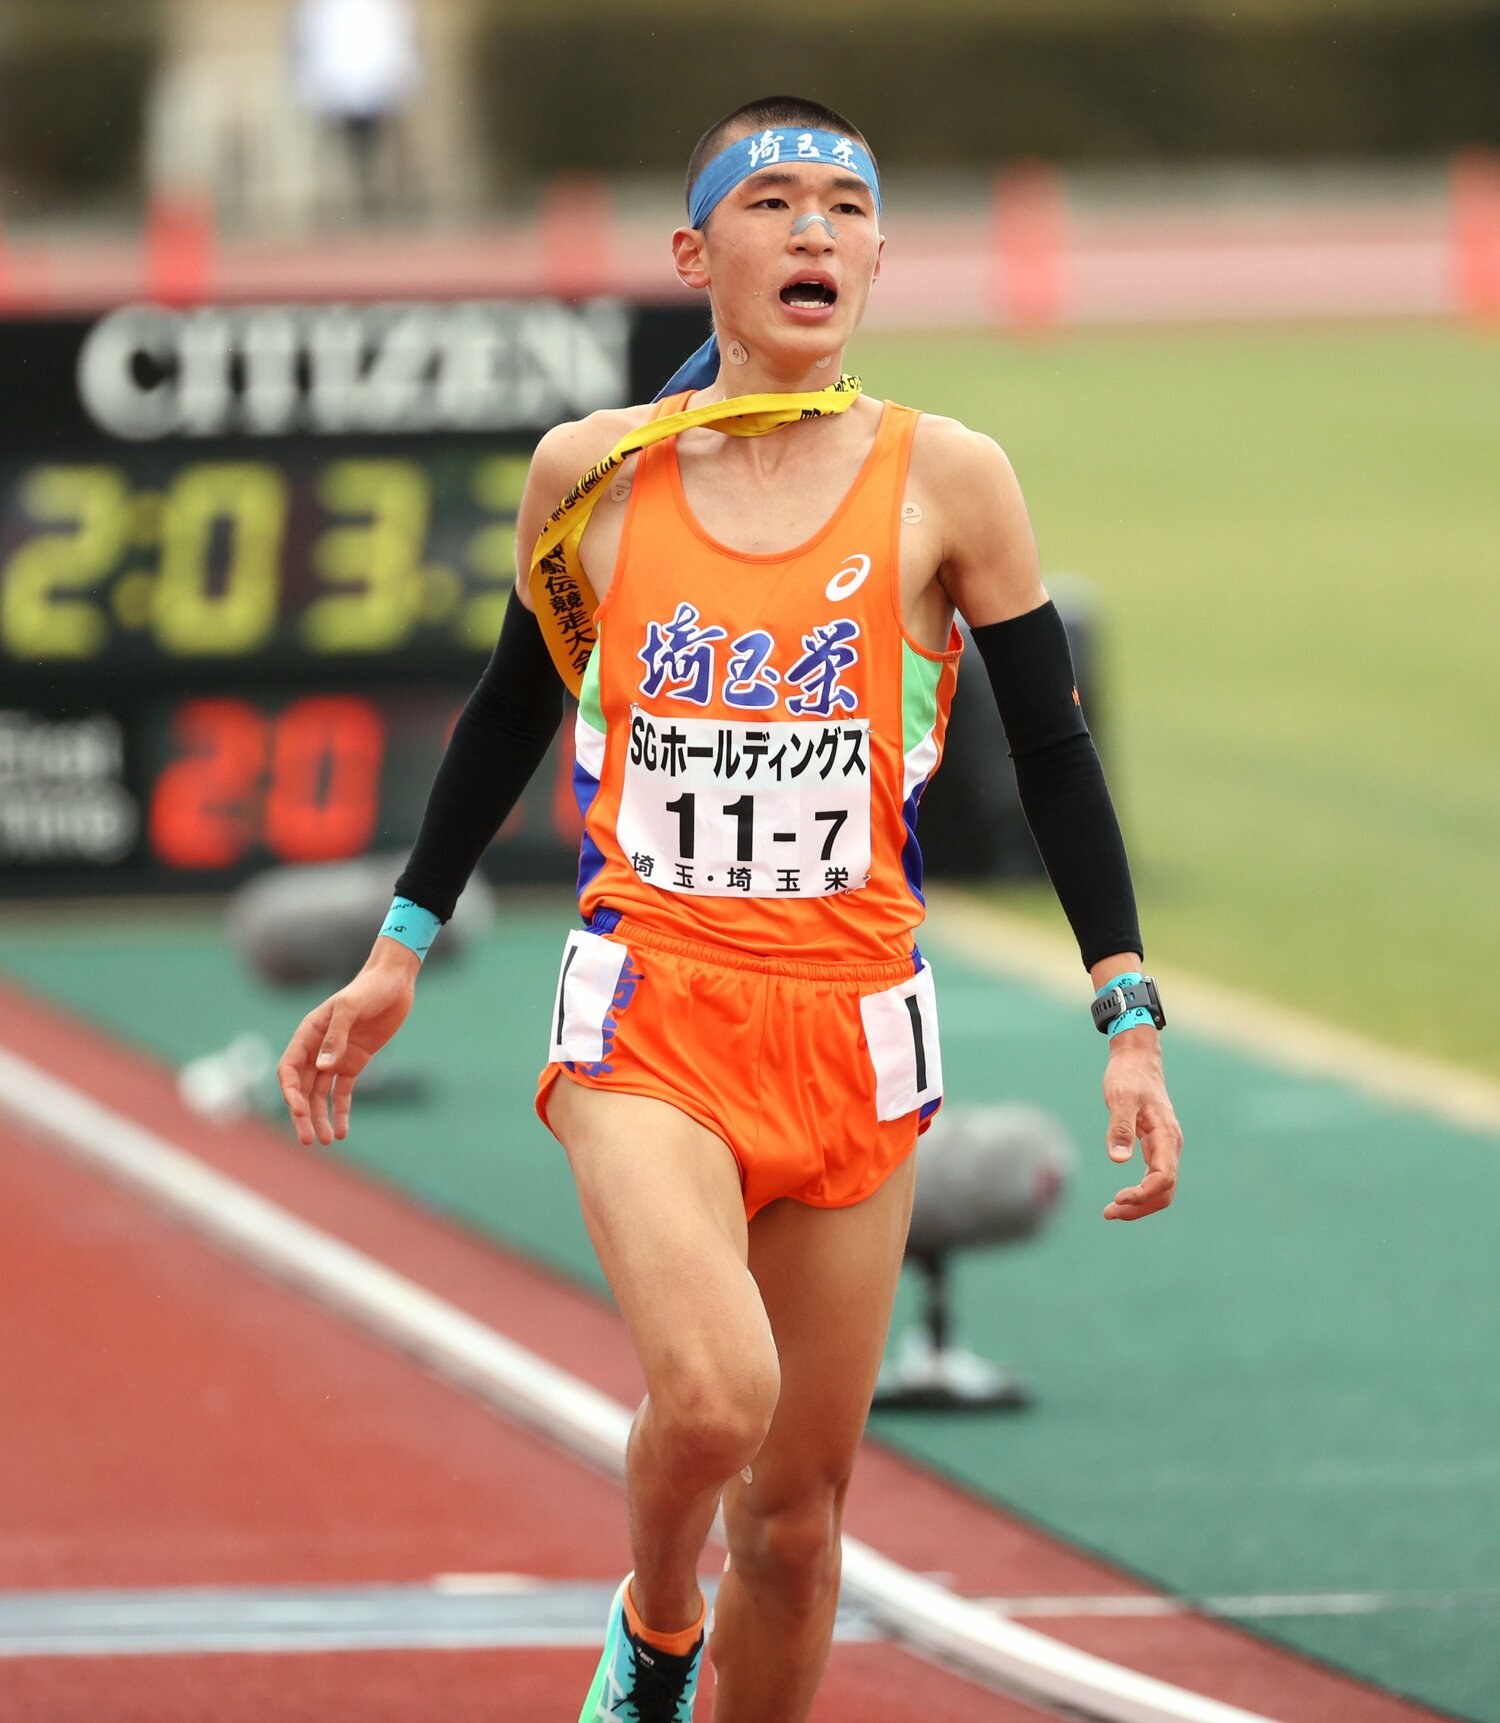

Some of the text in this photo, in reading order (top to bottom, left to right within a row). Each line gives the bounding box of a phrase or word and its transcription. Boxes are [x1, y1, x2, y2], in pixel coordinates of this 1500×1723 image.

[747, 129, 859, 171] 埼玉栄
[78, 302, 629, 440] CITIZEN
[637, 601, 861, 717] 埼玉栄
[630, 715, 867, 782] SGホールディングス
